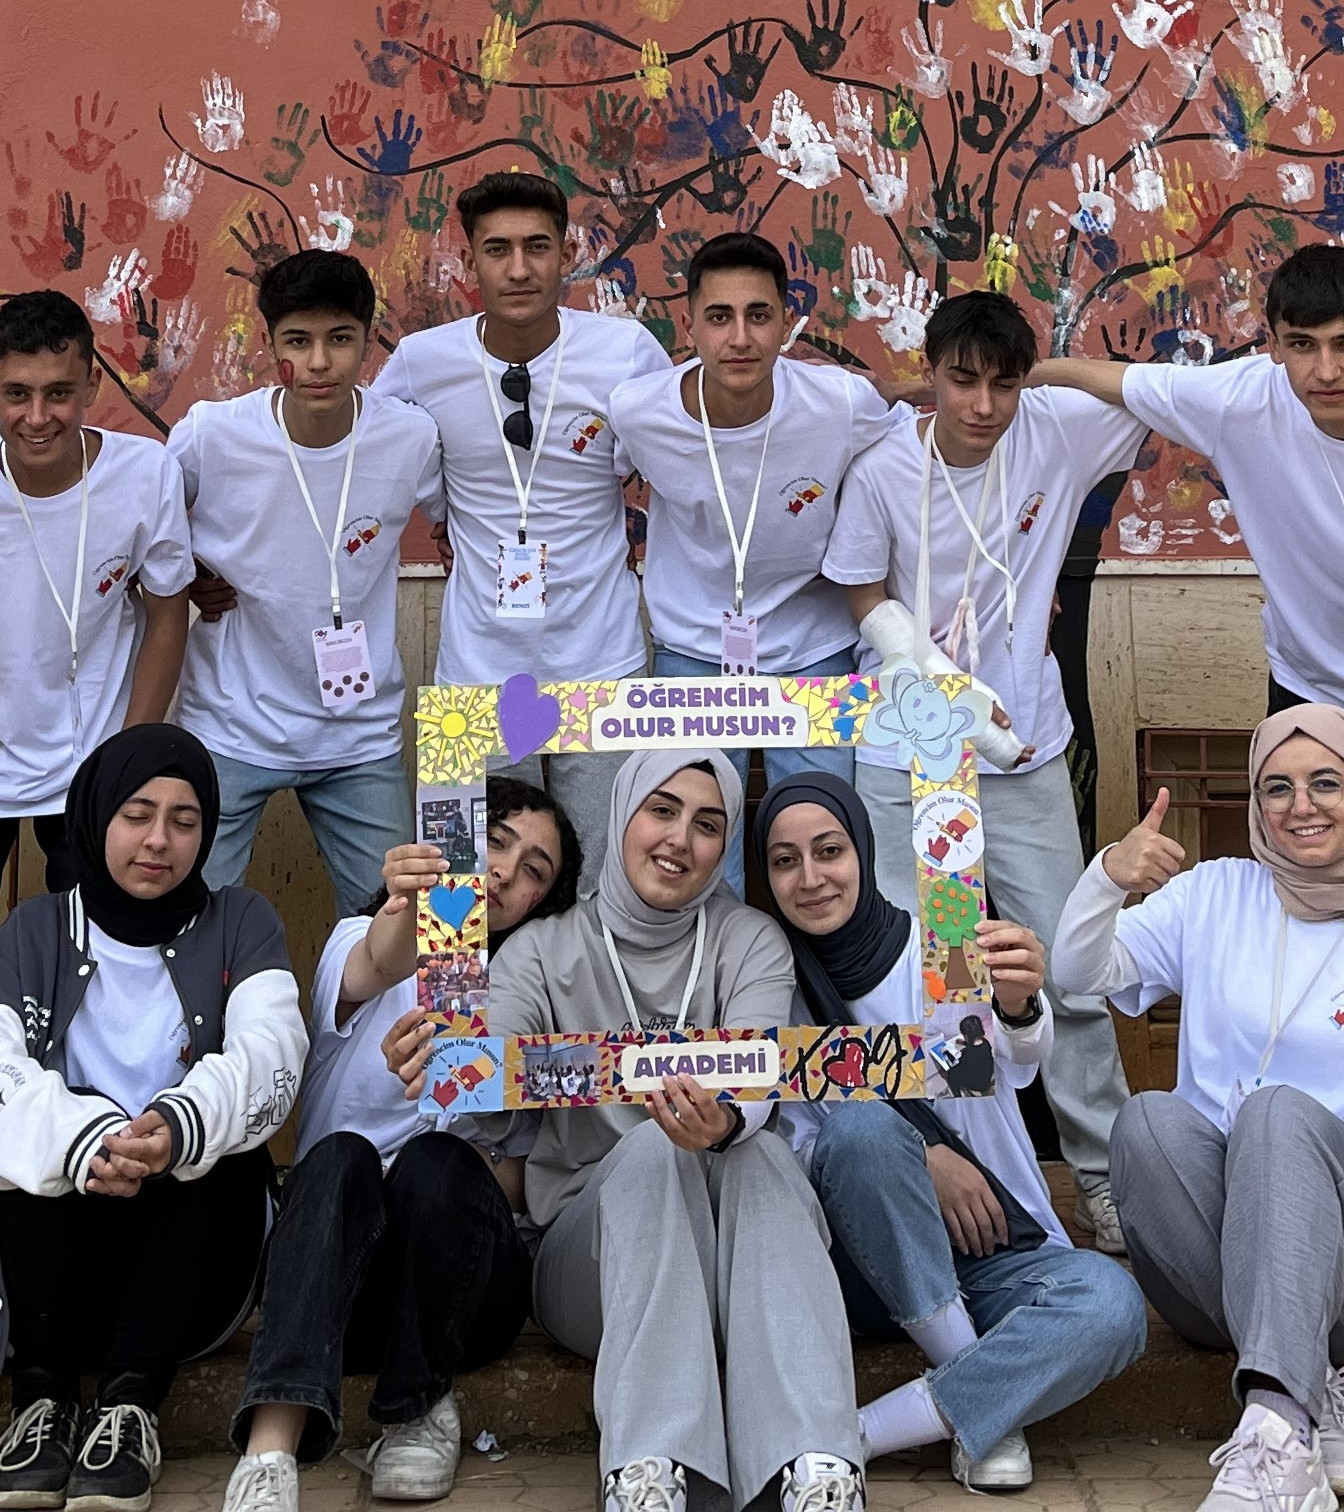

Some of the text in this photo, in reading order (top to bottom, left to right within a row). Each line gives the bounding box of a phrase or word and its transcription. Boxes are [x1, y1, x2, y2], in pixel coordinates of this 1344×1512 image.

[627, 682, 769, 709] ÖĞRENCİM
[601, 715, 796, 738] OLUR MUSUN?
[456, 1038, 476, 1048] Olur
[634, 1047, 766, 1078] AKADEMİ
